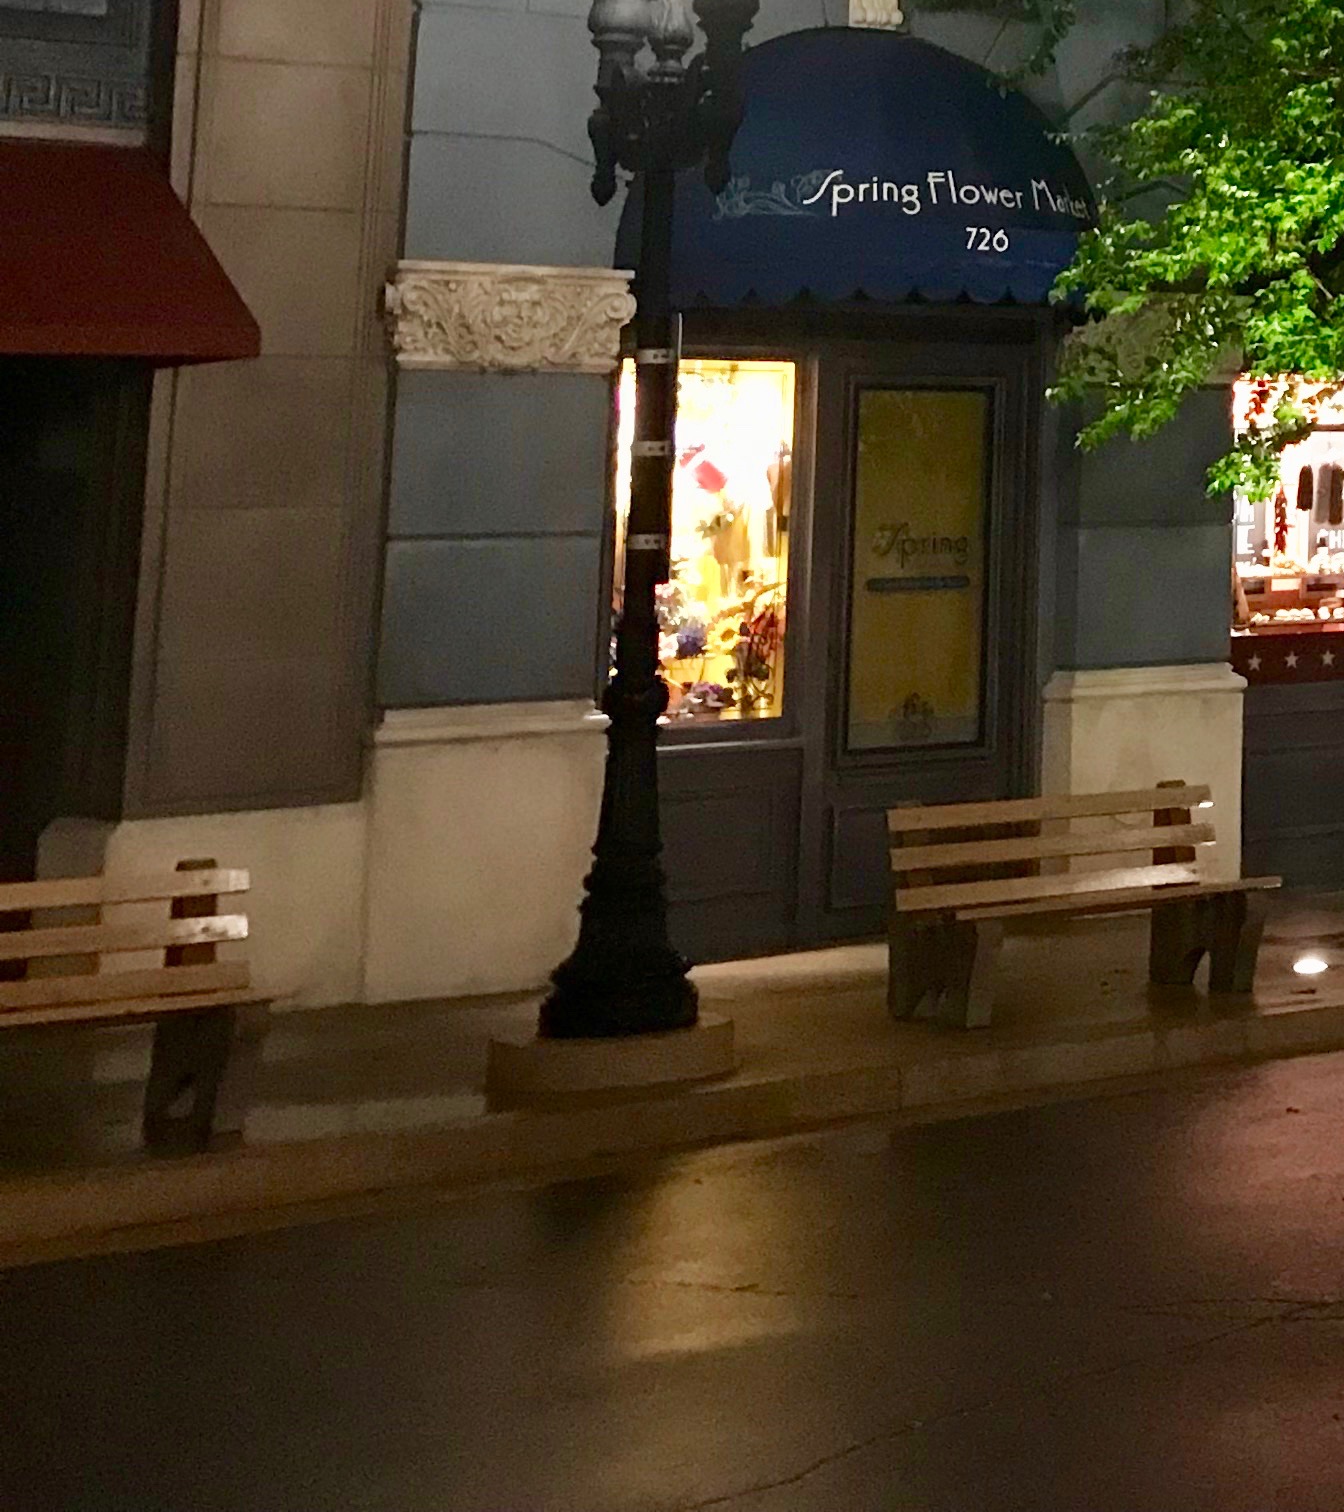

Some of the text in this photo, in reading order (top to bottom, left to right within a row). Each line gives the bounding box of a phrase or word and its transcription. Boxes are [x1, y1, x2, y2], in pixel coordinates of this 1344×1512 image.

[803, 169, 921, 217] Spring
[927, 170, 1023, 209] Flower
[965, 226, 1009, 252] 726
